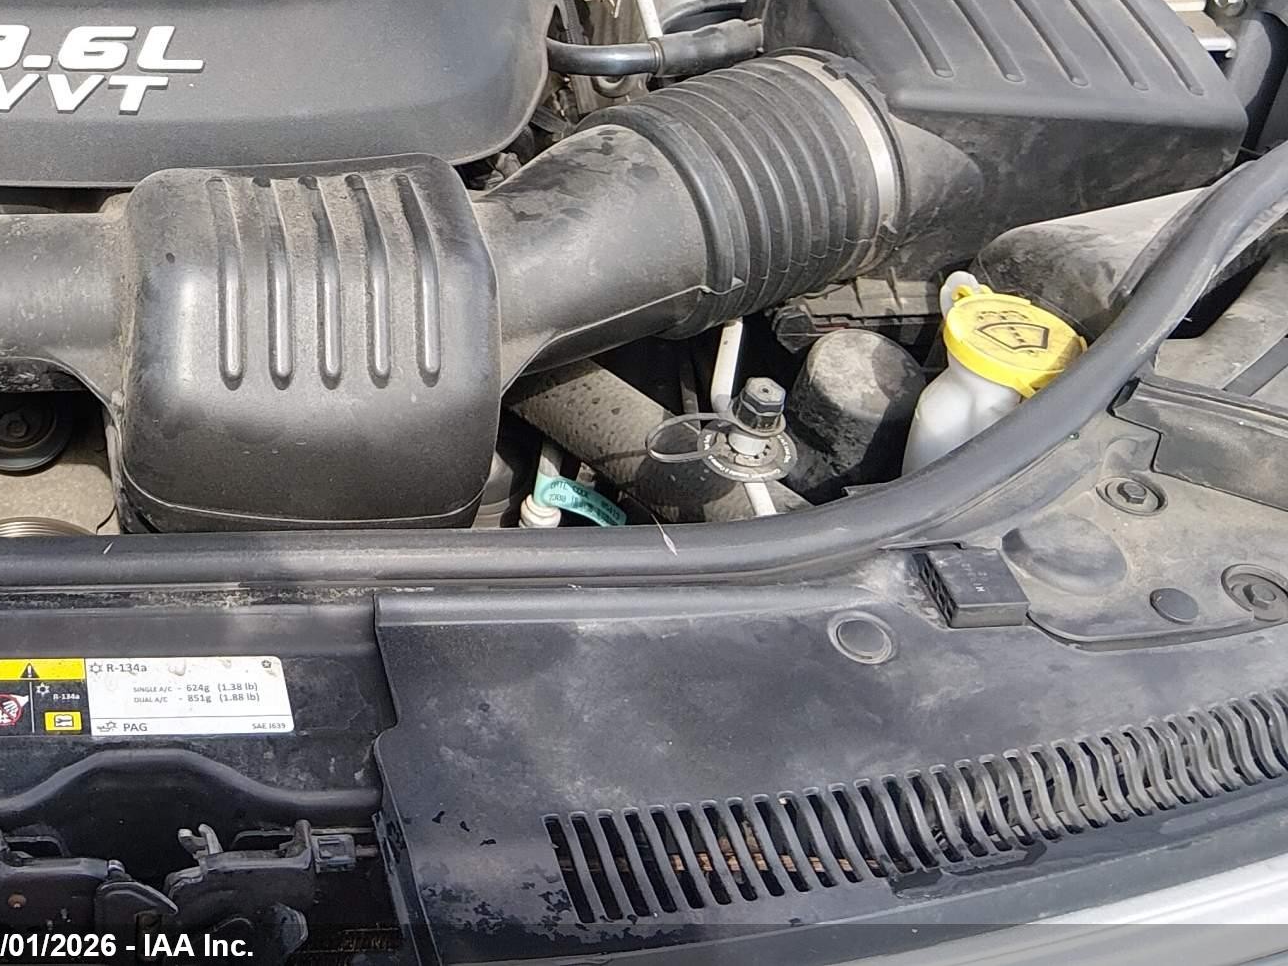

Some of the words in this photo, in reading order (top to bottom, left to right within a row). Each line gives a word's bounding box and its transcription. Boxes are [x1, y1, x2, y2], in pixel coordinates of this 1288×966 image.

[107, 663, 147, 672] R-134a
[186, 684, 210, 693] 624g
[217, 682, 243, 692] (1.38
[244, 682, 258, 692] lb)
[187, 694, 212, 703] 851g
[219, 693, 245, 703] (1.88
[246, 692, 260, 702] lb)
[123, 722, 148, 732] PAG
